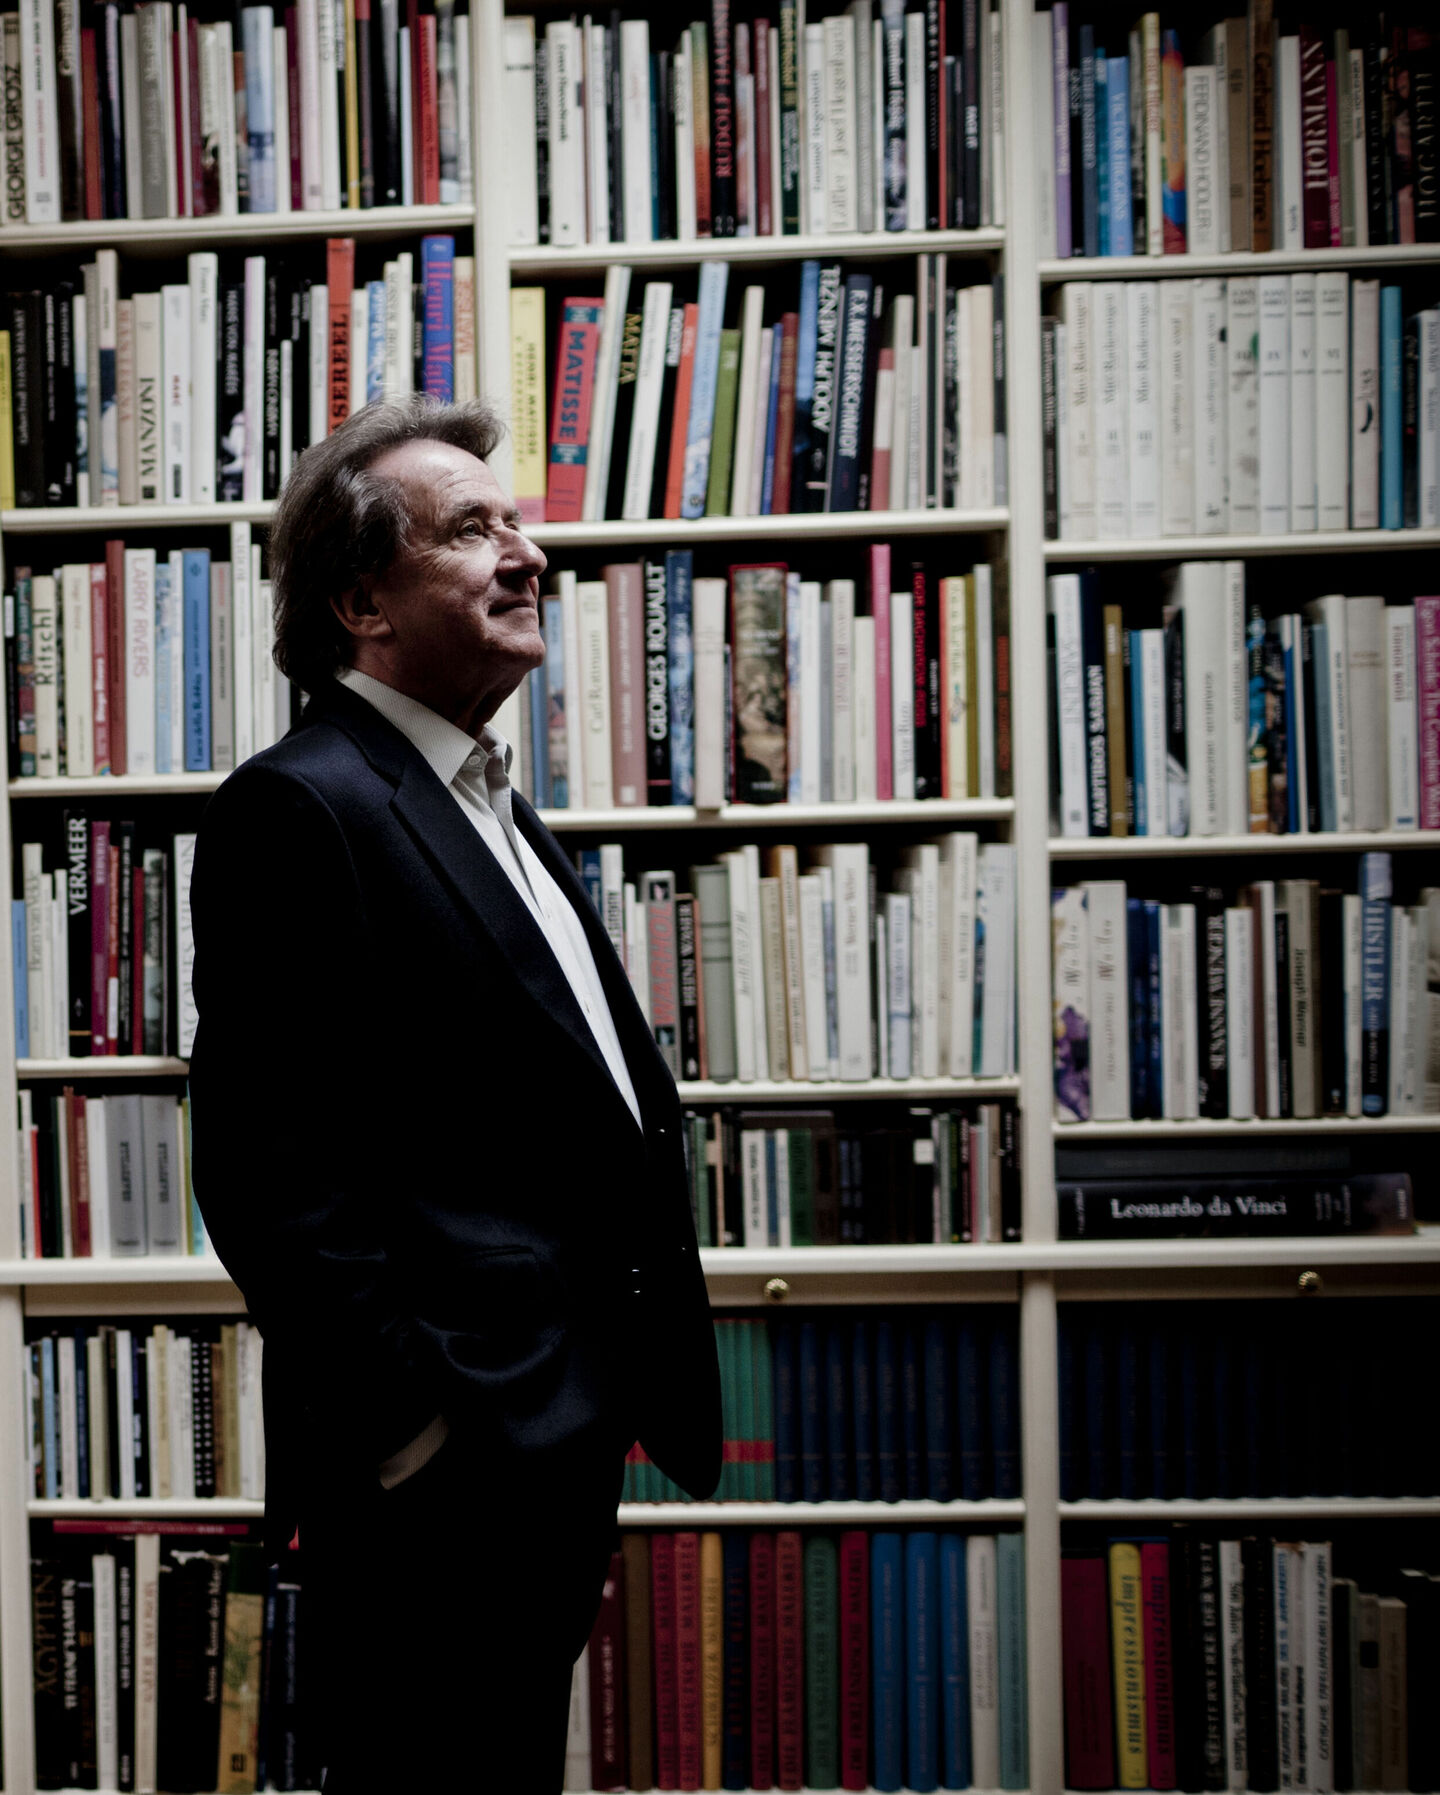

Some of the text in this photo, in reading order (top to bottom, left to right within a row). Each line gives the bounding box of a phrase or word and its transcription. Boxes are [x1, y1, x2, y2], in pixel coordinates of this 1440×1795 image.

[5, 65, 26, 218] GEORGE GROSZ
[714, 92, 732, 177] RUDOLF
[140, 378, 155, 476] MANZONI
[560, 331, 586, 438] MATISSE
[812, 352, 835, 432] ADOLPH
[35, 608, 52, 686] Ritschl
[645, 562, 667, 740] GEORGES ROUAULT
[68, 818, 87, 914] VERMEER
[1110, 1196, 1286, 1216] Leonardo da Vinci
[1120, 1576, 1142, 1754] impressionismus
